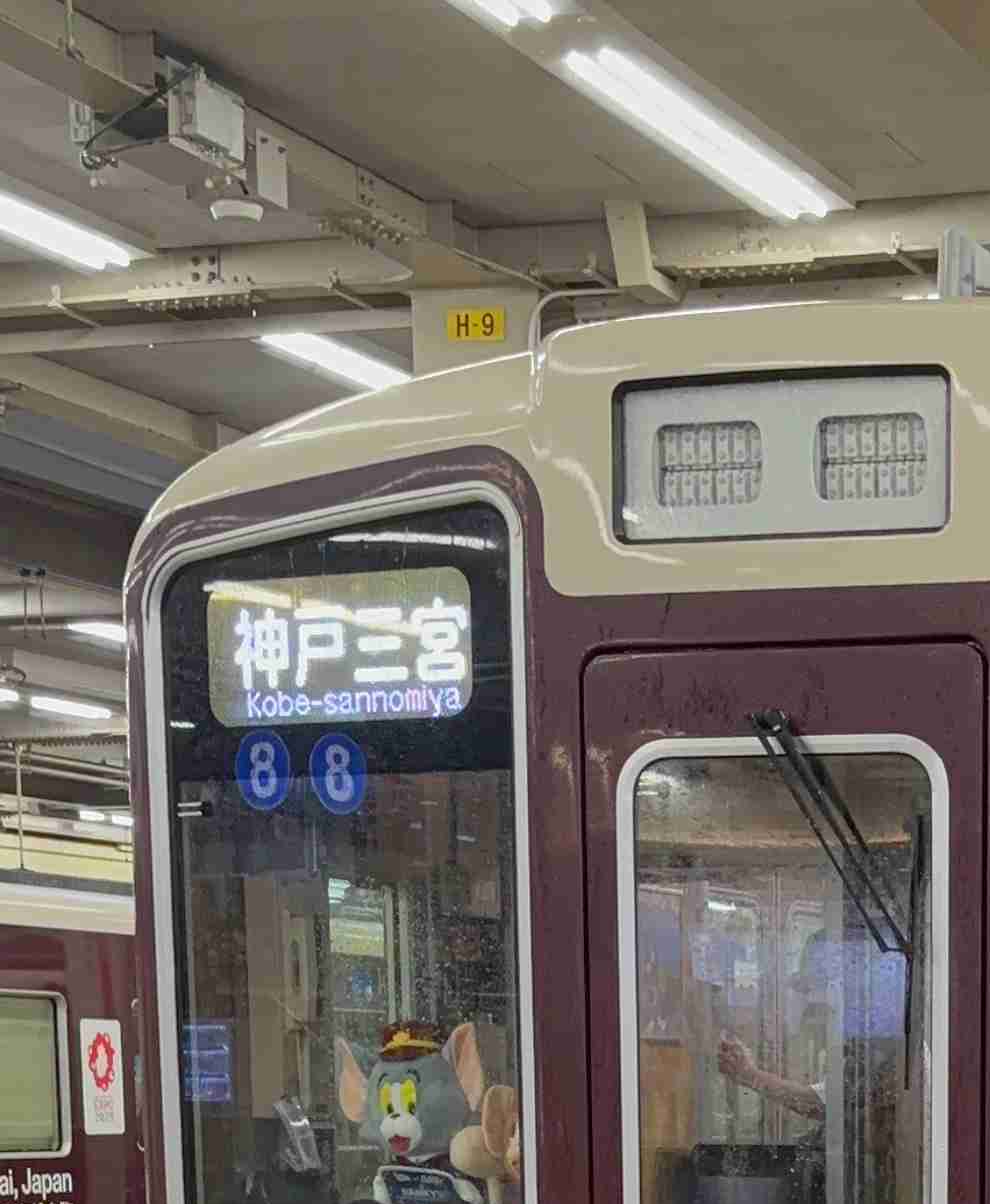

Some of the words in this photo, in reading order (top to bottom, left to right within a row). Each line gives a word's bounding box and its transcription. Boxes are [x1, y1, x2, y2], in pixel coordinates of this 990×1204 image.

[456, 313, 495, 337] H-9
[234, 597, 468, 690] 神戸三宮
[247, 686, 462, 719] Kobe-sannomiya
[250, 742, 277, 798] 8
[325, 744, 354, 801] 8
[21, 1167, 73, 1200] Japan
